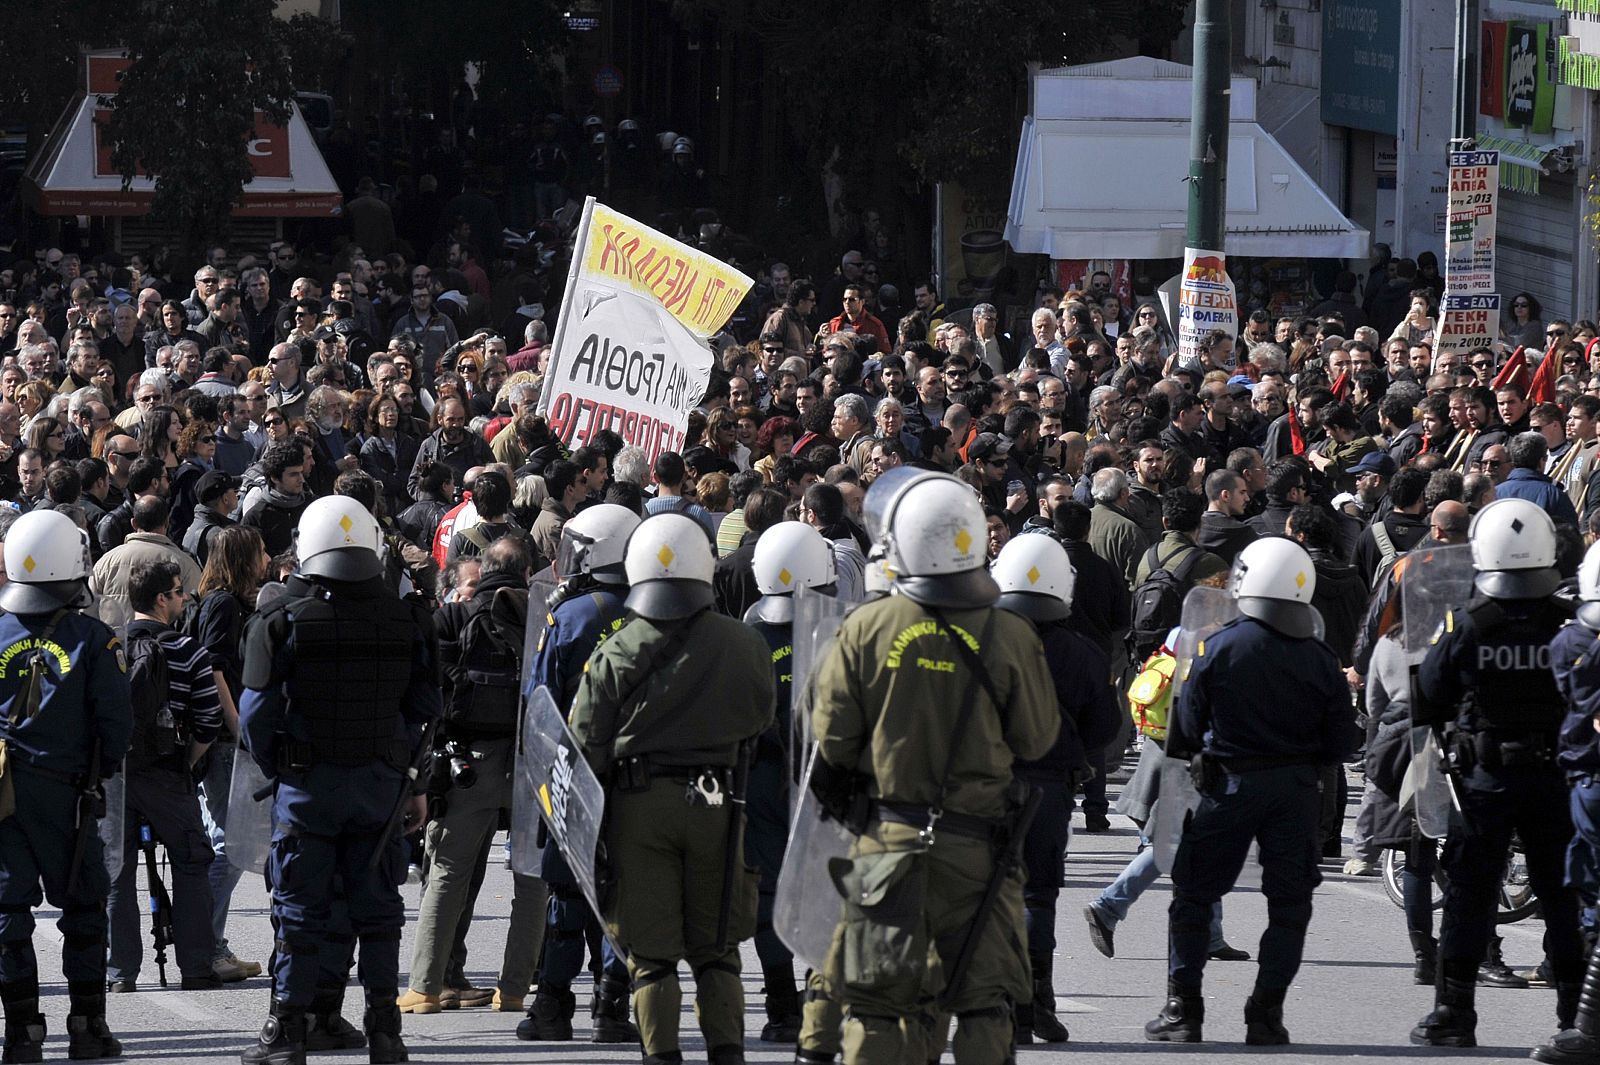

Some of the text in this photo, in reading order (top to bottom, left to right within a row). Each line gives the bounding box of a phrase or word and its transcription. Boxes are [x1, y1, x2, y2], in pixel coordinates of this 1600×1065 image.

[1451, 155, 1467, 165] ΕΕ
[1450, 213, 1472, 222] ΟΥΜΕ
[770, 645, 793, 662] ΝΙΚΗ
[1477, 645, 1551, 670] POLIC
[916, 657, 957, 673] POLICE
